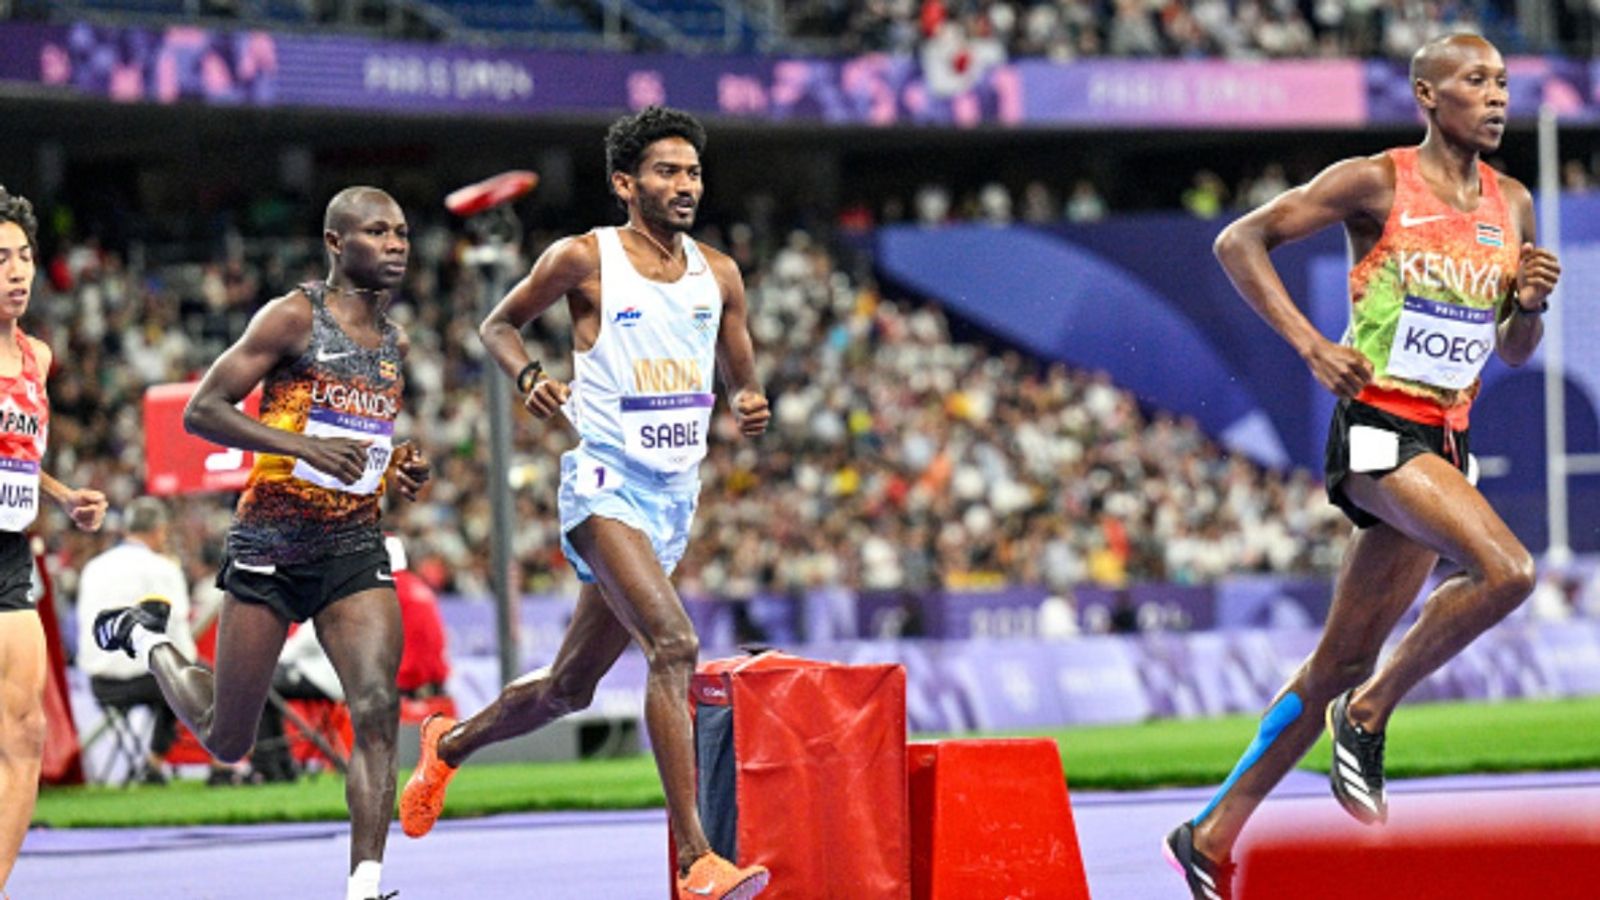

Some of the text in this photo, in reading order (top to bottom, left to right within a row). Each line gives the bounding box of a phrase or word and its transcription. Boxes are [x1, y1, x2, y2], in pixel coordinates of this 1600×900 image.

[1399, 250, 1502, 299] KENYA
[632, 357, 702, 393] INDIA
[0, 410, 39, 435] PAN
[639, 420, 699, 449] SABLE
[593, 467, 605, 488] 1
